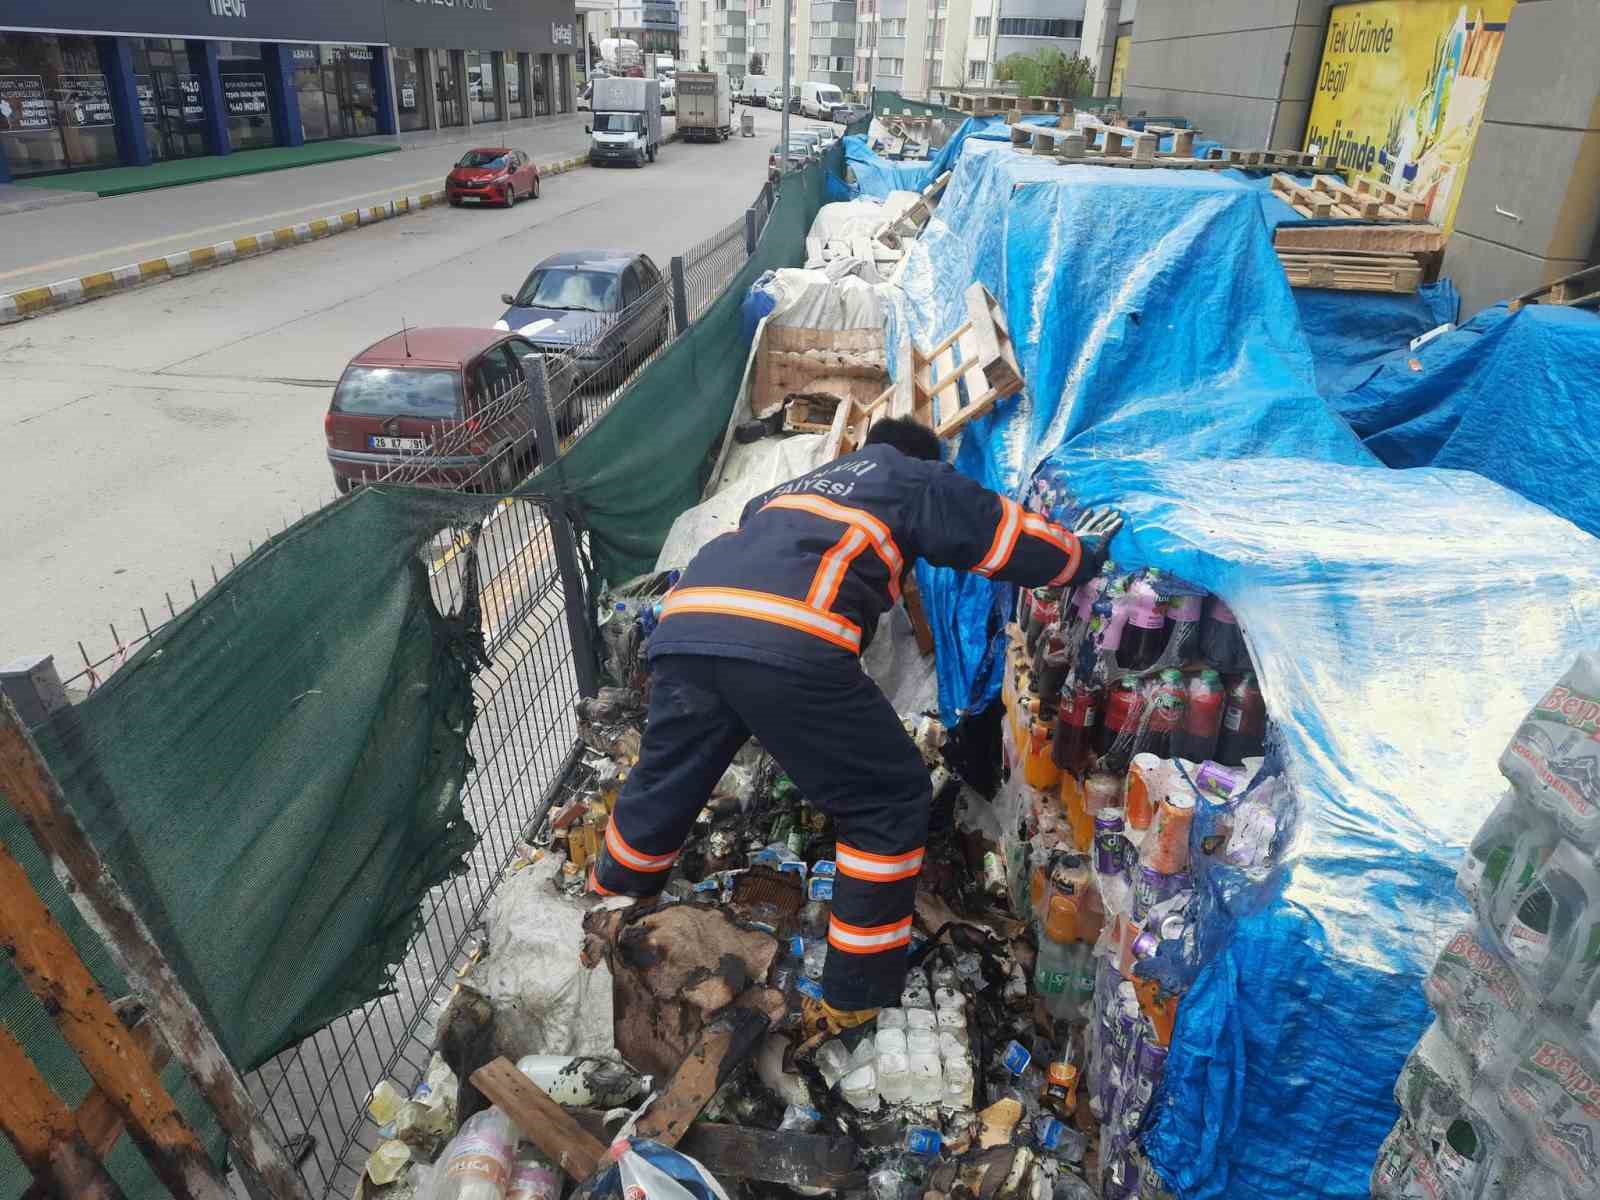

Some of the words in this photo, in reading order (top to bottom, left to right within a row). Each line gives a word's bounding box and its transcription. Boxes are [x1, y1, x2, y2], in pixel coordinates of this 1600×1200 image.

[1329, 22, 1346, 53] Tek
[1349, 12, 1393, 53] Üründe
[1320, 61, 1349, 100] Değil
[1329, 120, 1375, 172] Üründe
